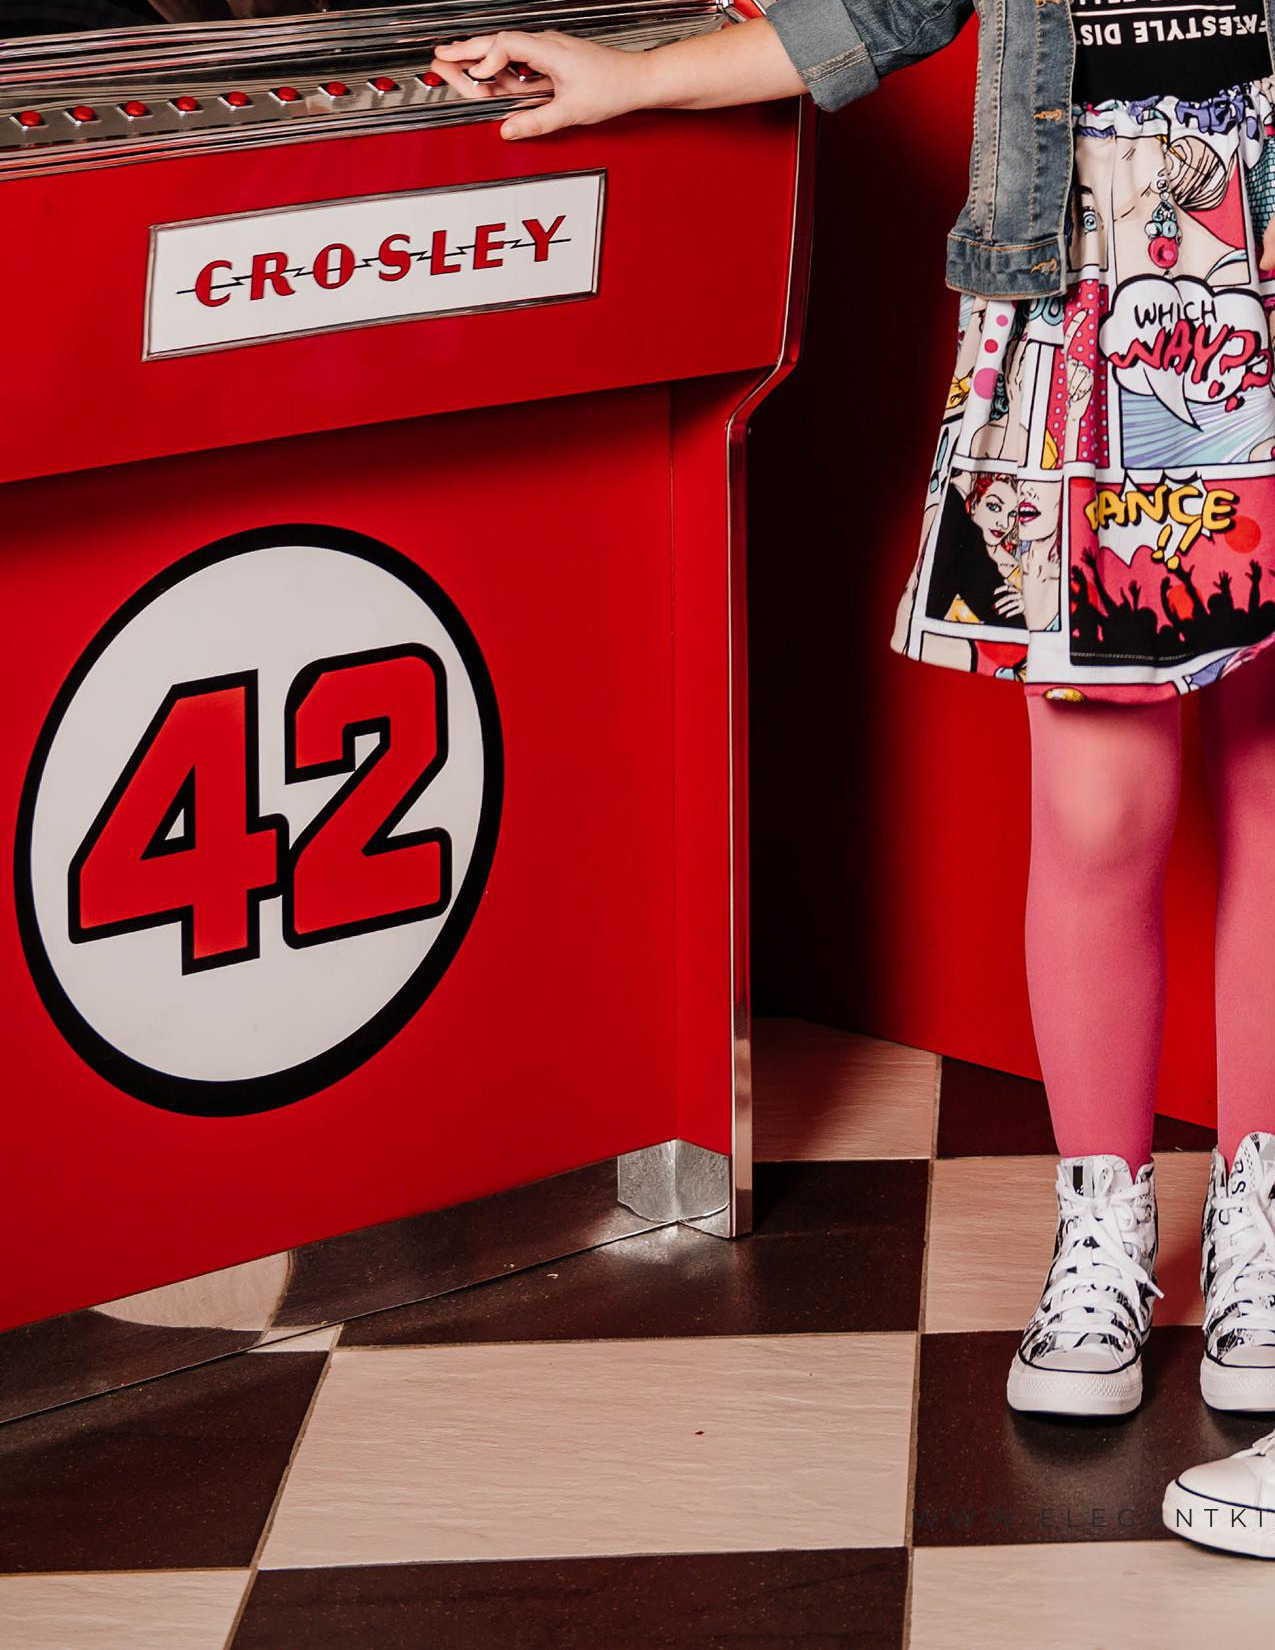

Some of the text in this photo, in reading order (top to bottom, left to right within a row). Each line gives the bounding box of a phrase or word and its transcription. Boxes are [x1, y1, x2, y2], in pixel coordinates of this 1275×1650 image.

[194, 214, 567, 308] CROSLEY
[1133, 298, 1218, 329] WHICH
[1084, 483, 1239, 532] DANCE
[67, 641, 453, 977] 42
